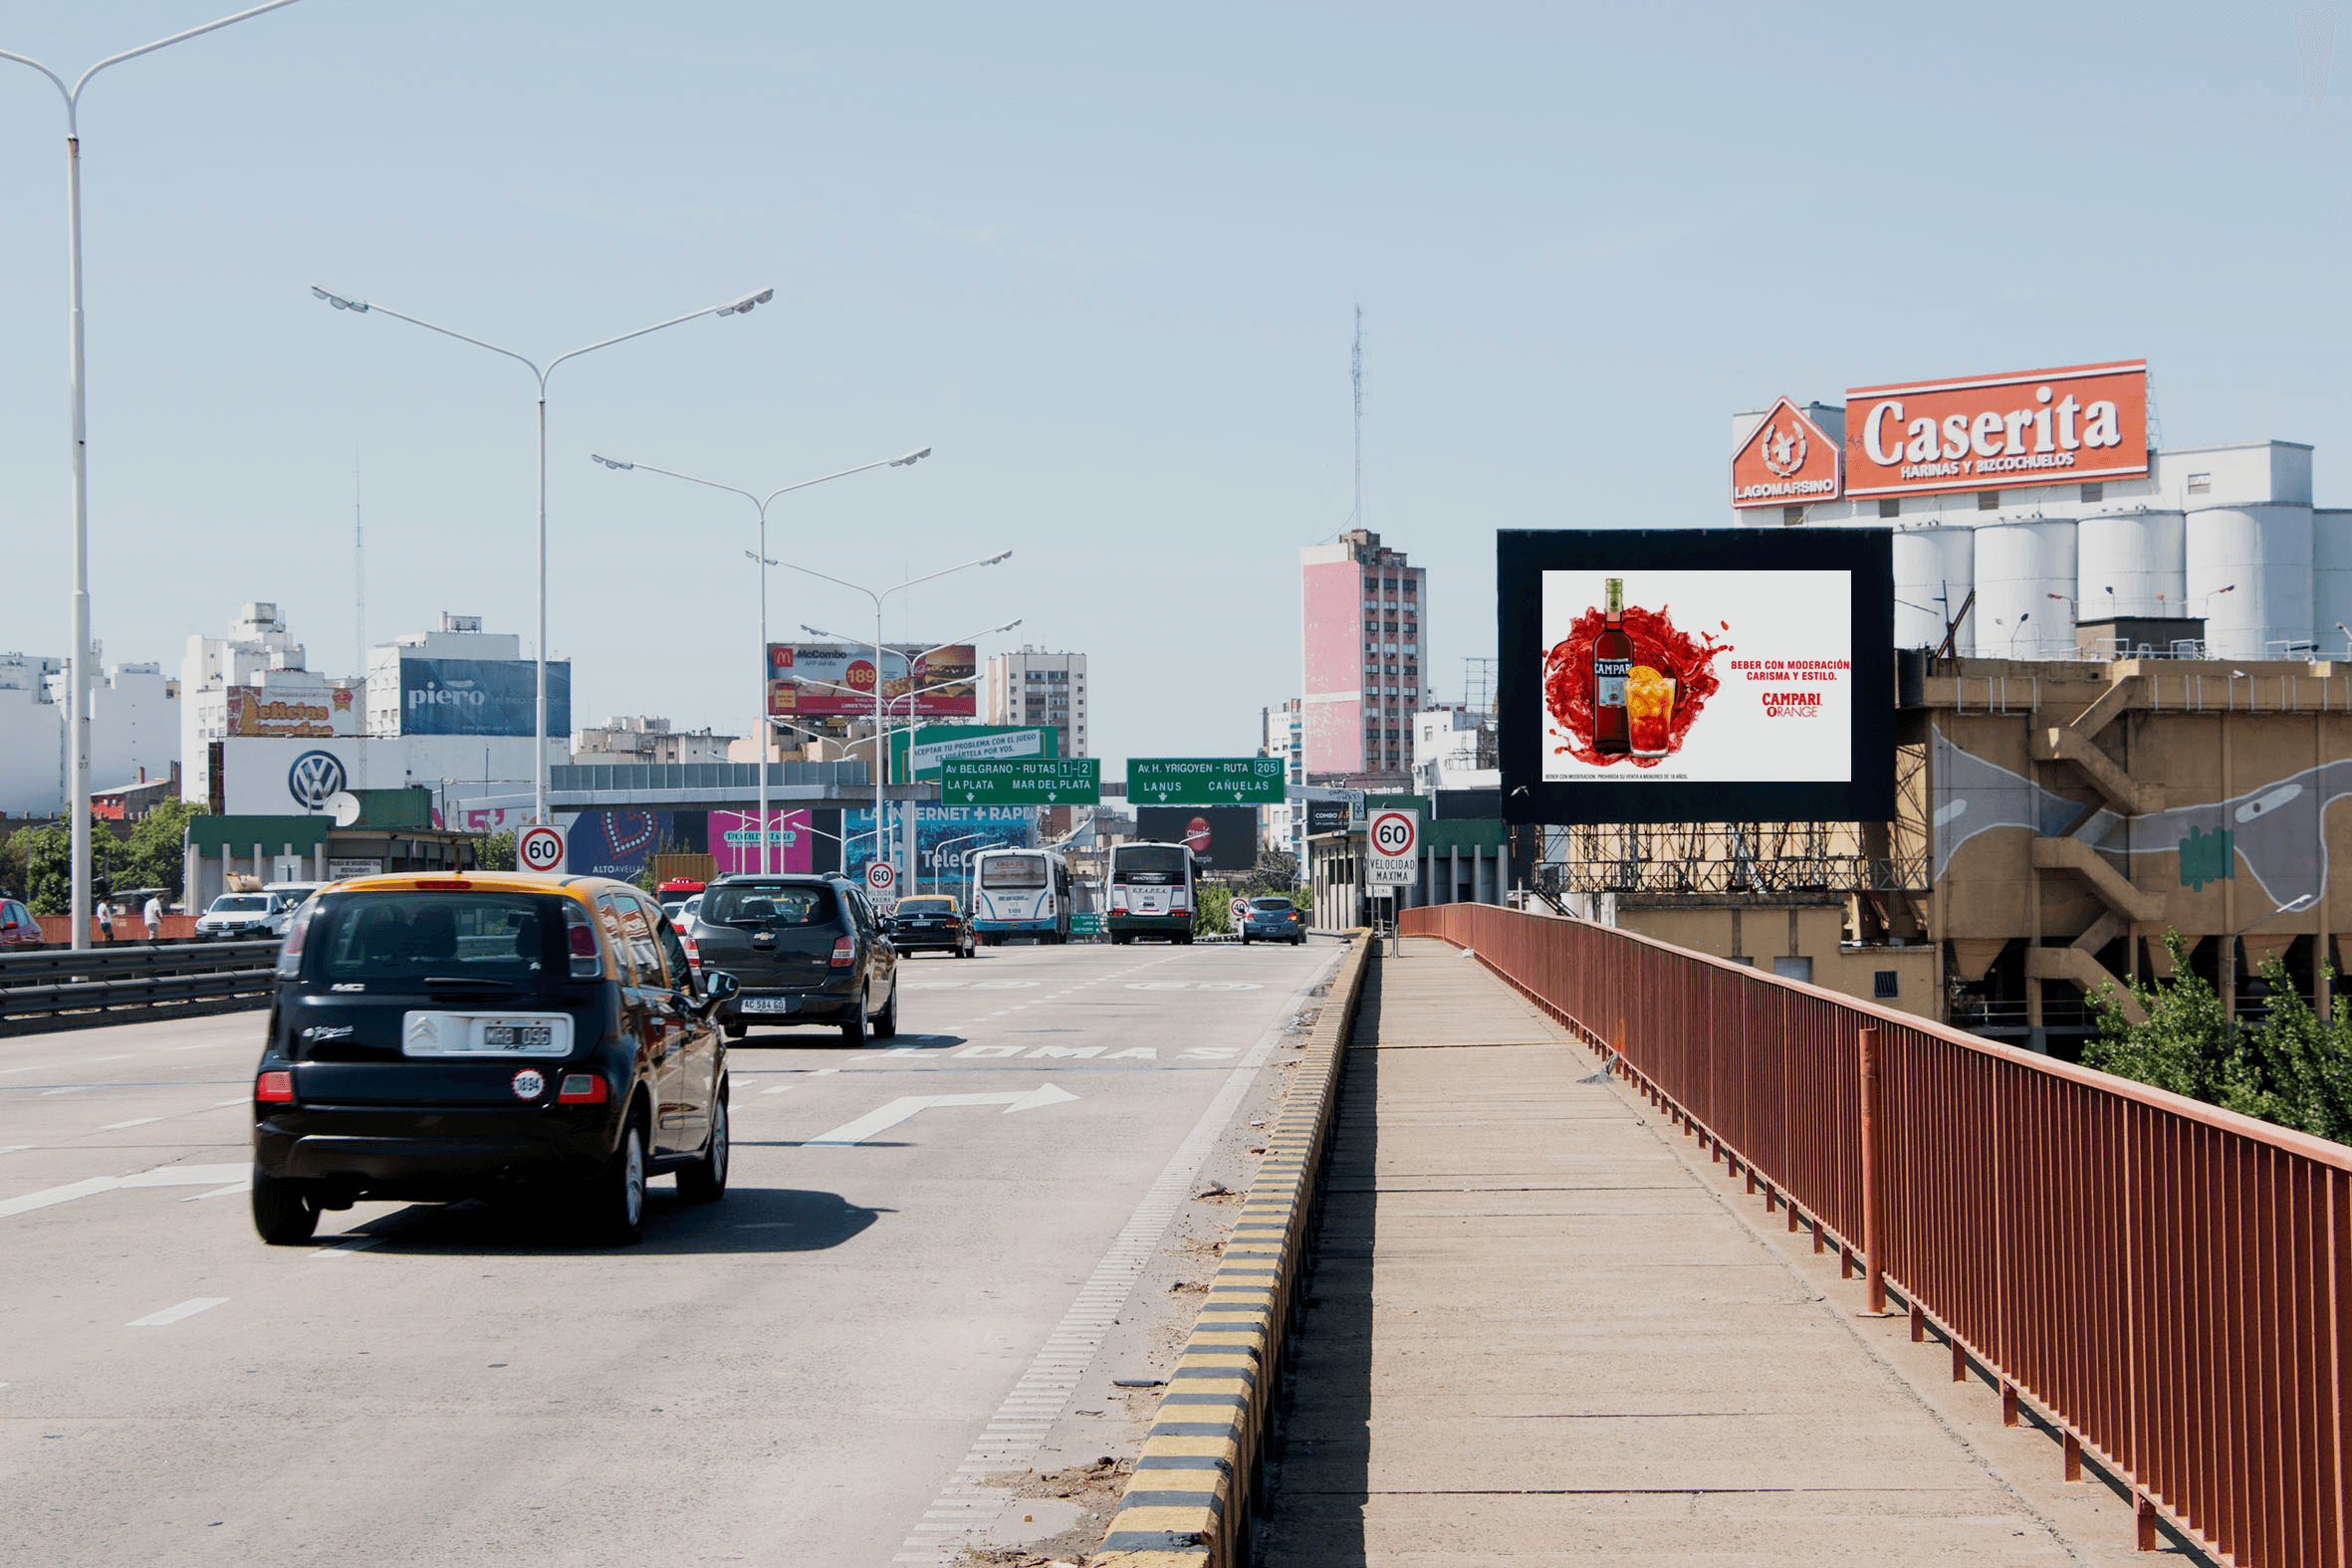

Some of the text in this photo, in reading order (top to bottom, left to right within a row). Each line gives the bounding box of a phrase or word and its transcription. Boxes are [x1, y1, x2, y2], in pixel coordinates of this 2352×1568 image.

[1864, 385, 2122, 466] Caserita
[1901, 451, 2075, 479] HARINAS Y BIZCOCHUELOS
[1734, 479, 1834, 500] LAGOMARSINO
[797, 649, 846, 659] McCombo
[1731, 660, 1762, 670] BEBER
[1764, 660, 1784, 670] CON
[847, 669, 876, 683] 189
[1747, 671, 1790, 681] CARISMA
[1801, 671, 1837, 681] ESTILO.
[408, 681, 485, 709] piero
[1762, 693, 1821, 707] CAMPARI
[1766, 706, 1817, 718] ORANGE
[954, 739, 990, 751] PROBLEMA
[1016, 733, 1037, 743] JUEGO
[959, 764, 1013, 774] BELGRANO
[1023, 764, 1056, 774] RUTAS
[1081, 764, 1088, 774] 2
[1152, 764, 1162, 774] H.
[1165, 764, 1213, 774] YRIGOYEN
[1223, 764, 1249, 774] RUTA
[1257, 763, 1277, 774] 205
[947, 780, 994, 789] LA PLATA
[1012, 780, 1091, 789] MAR DEL PLATA
[1143, 782, 1182, 791] LANUS
[1208, 779, 1269, 790] CAÑUELAS
[887, 806, 969, 821] INERNET
[1379, 825, 1407, 844] 60
[528, 840, 556, 859] 60
[1369, 859, 1415, 870] VELOCIDAD
[872, 870, 889, 882] 60
[1376, 871, 1409, 882] MAXIMA
